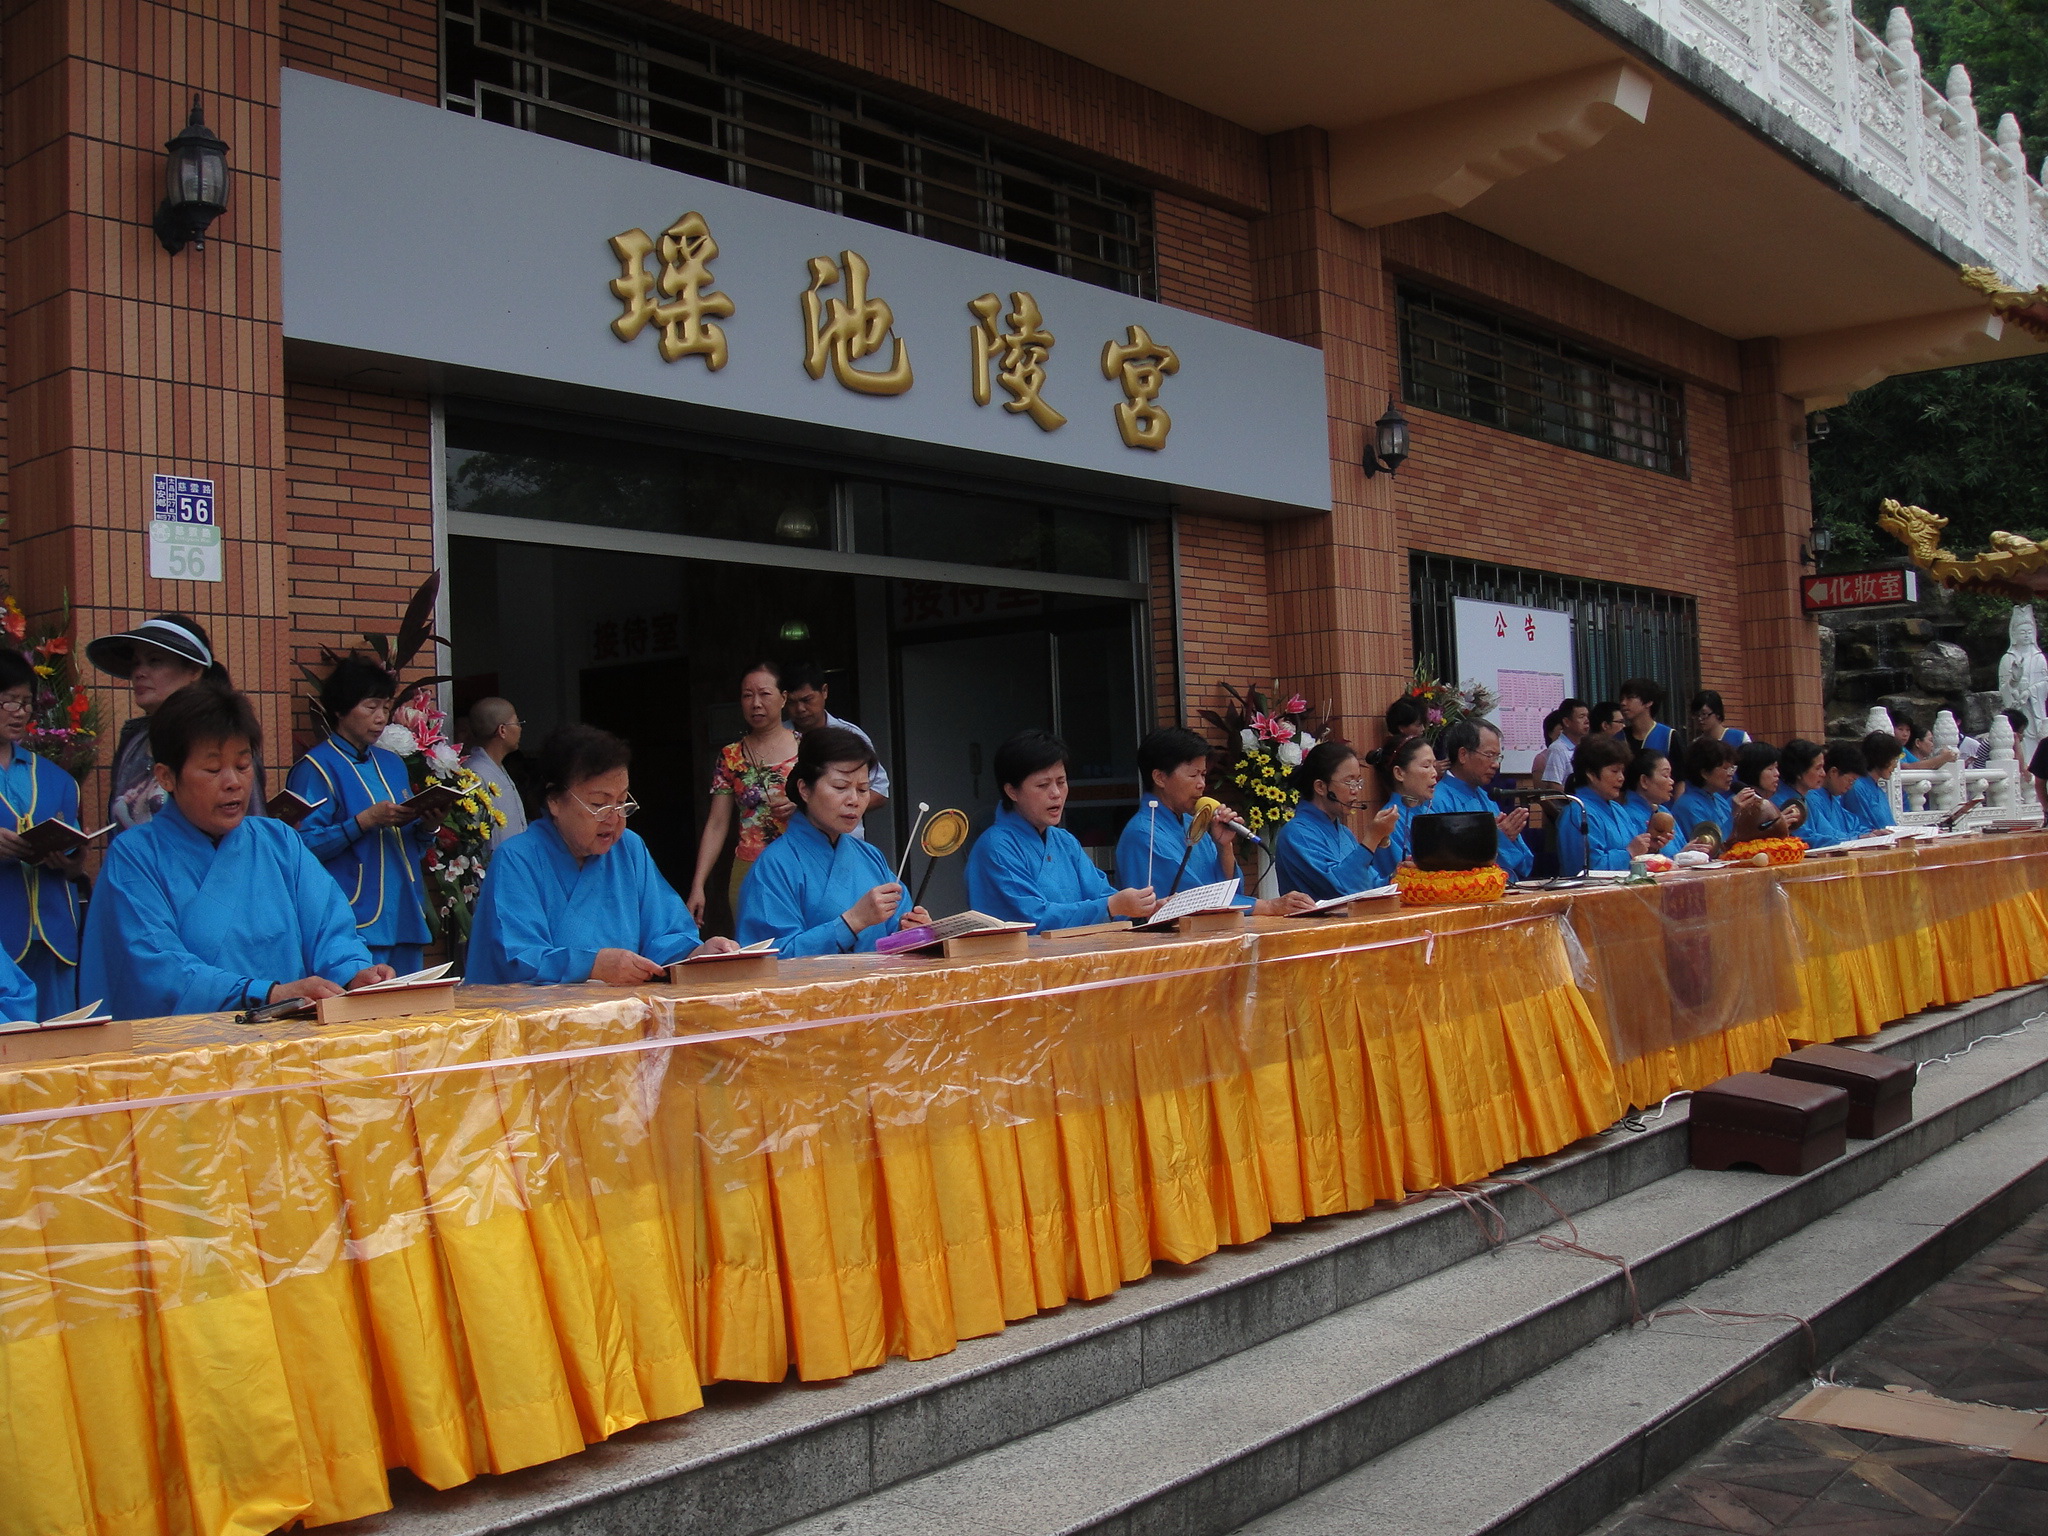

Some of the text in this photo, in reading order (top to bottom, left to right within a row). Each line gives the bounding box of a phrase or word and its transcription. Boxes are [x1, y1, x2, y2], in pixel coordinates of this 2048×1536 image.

[181, 498, 208, 522] 56
[169, 545, 205, 577] 56
[1829, 573, 1902, 604] 化妝室
[593, 612, 678, 660] 接待室
[1494, 611, 1536, 641] 公告
